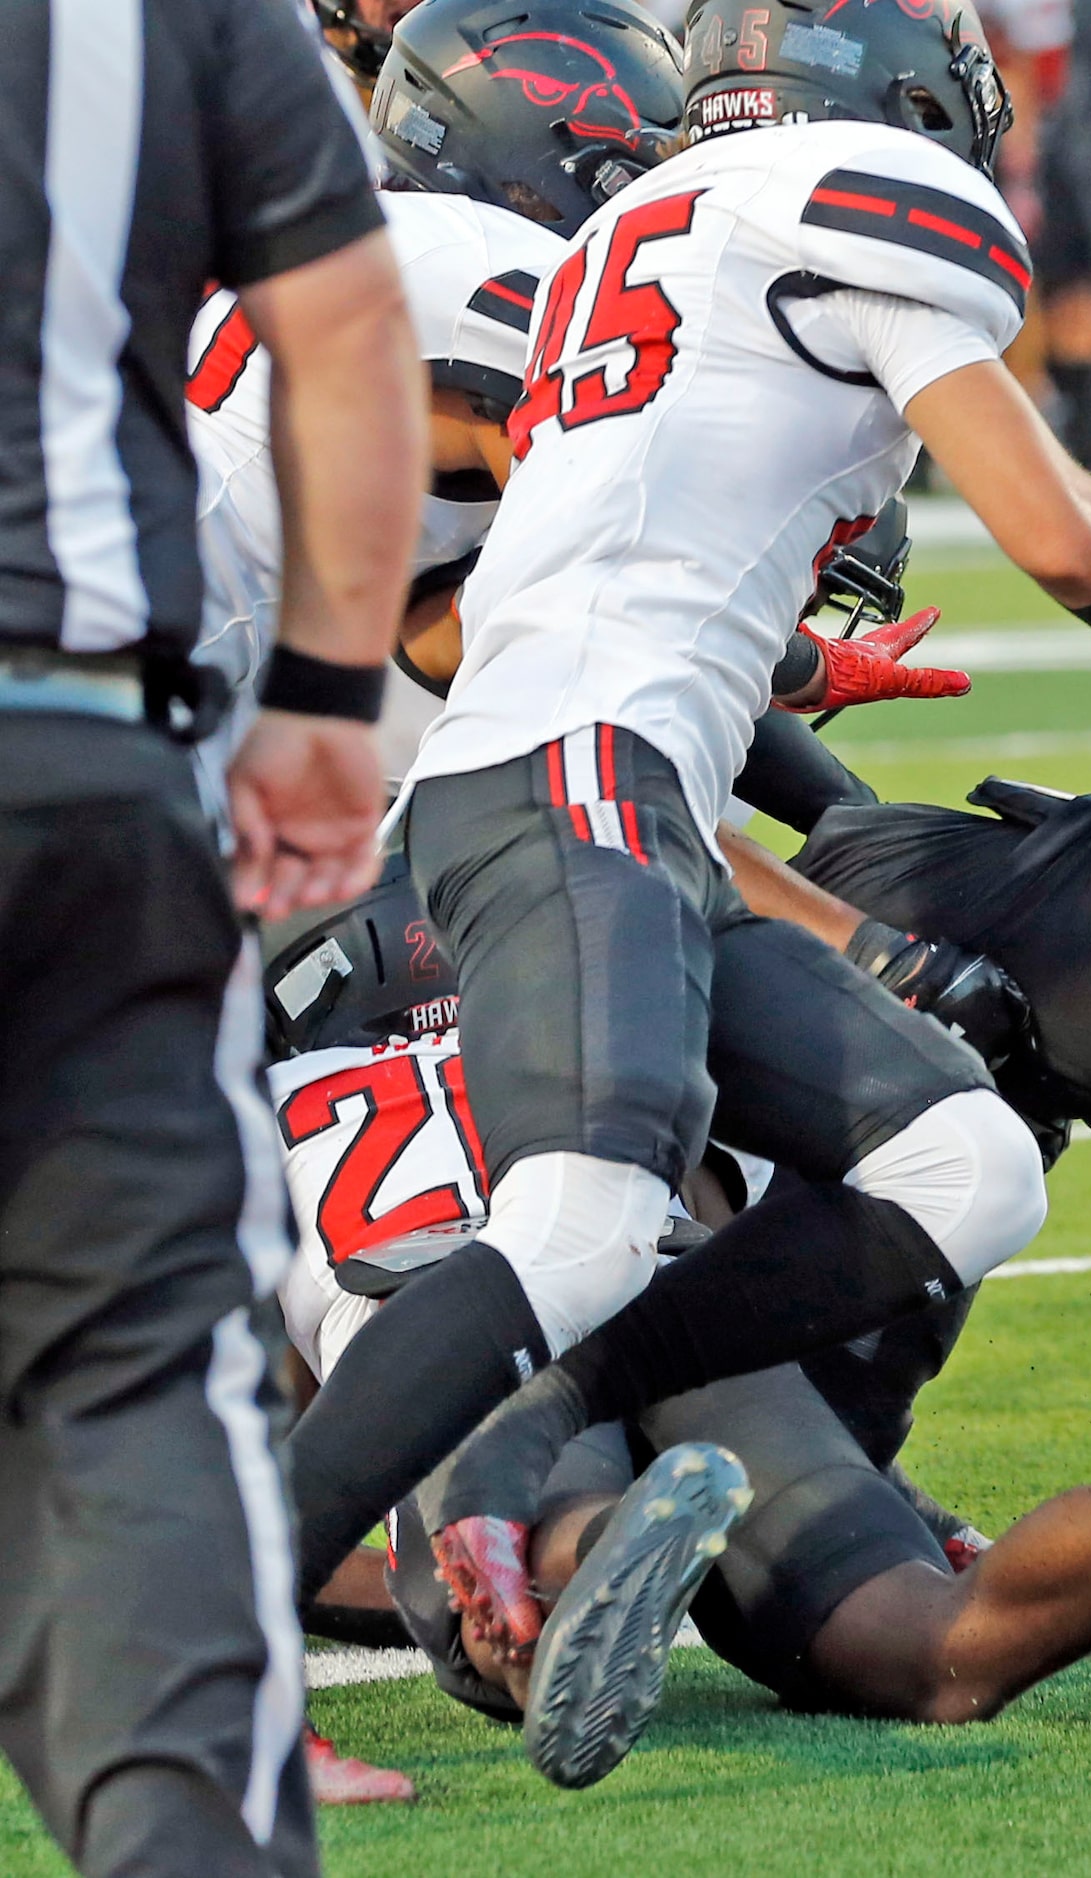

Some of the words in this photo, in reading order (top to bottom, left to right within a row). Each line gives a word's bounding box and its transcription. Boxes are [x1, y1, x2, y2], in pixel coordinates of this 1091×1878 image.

[702, 8, 770, 75] 45
[702, 90, 775, 125] HAWKS
[507, 187, 713, 462] 45
[277, 1055, 490, 1266] 2
